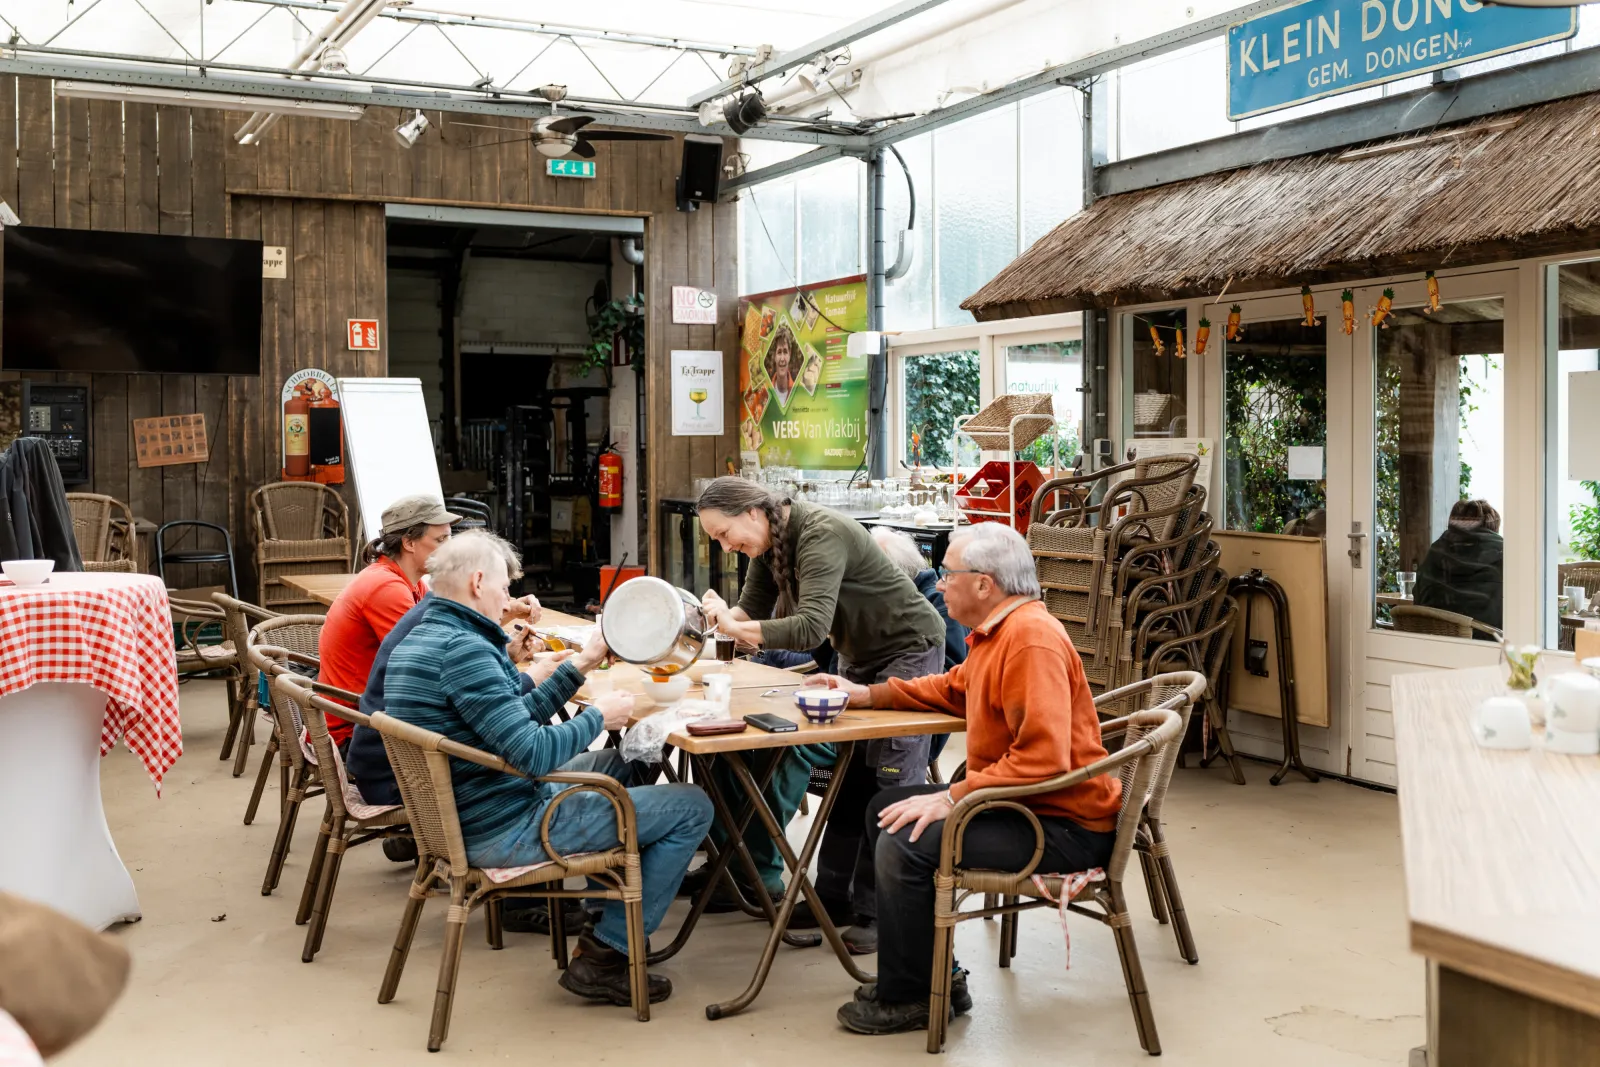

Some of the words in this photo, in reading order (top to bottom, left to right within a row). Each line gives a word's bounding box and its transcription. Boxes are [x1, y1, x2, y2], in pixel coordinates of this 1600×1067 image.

[1240, 10, 1340, 77] KLEIN
[1362, 0, 1484, 42] DON
[1308, 59, 1352, 88] GEM.
[1366, 29, 1458, 73] DONGEN
[263, 259, 283, 268] appe
[676, 289, 696, 306] NO
[676, 309, 717, 321] SMOKING
[690, 365, 716, 377] Trappe
[773, 421, 801, 439] VERS
[802, 420, 822, 438] Van
[824, 418, 861, 443] Vlakbij
